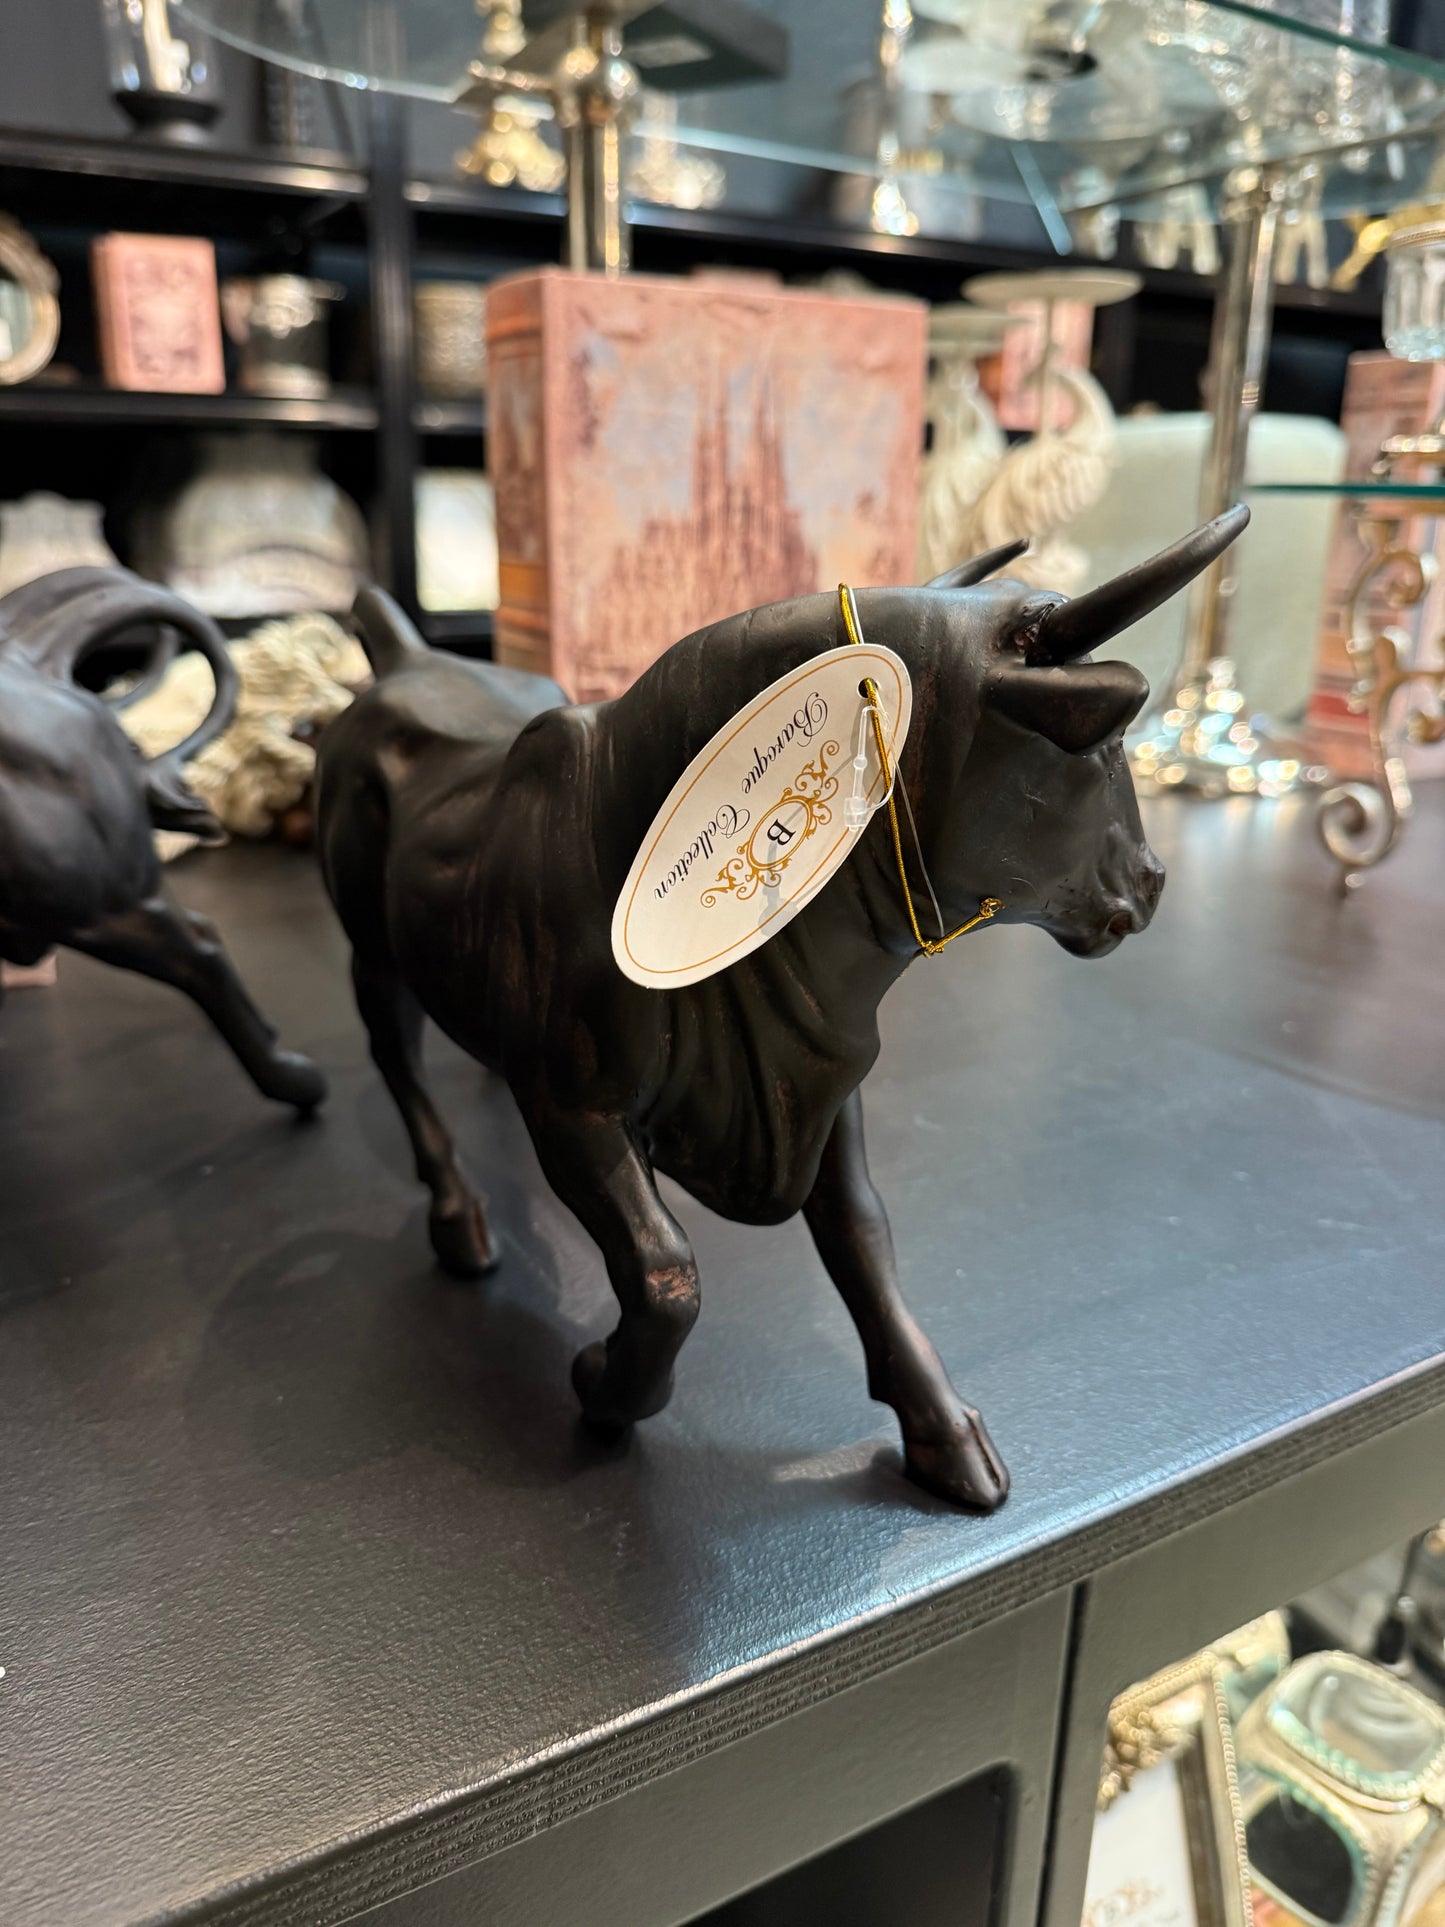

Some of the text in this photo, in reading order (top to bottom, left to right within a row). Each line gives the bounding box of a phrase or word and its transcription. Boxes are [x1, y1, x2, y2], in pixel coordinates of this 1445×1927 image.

[653, 691, 828, 899] Baroque Collection
[766, 818, 797, 846] B
